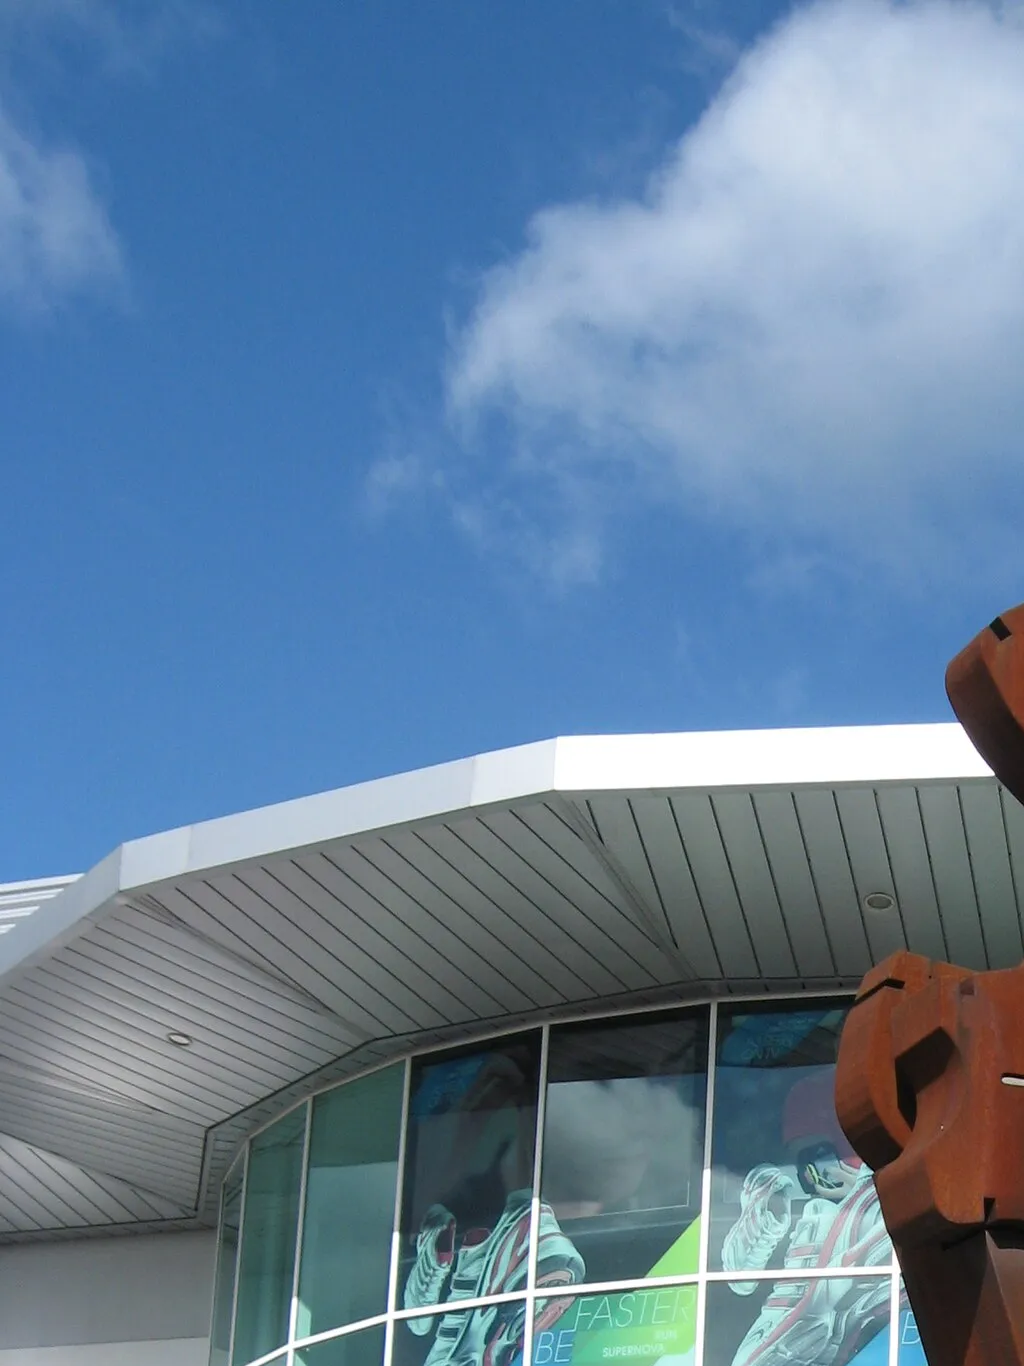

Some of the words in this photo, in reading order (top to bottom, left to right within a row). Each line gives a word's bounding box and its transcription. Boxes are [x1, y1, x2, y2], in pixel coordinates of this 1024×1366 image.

[573, 1288, 695, 1331] FASTER
[534, 1329, 575, 1364] BE
[602, 1343, 666, 1359] SUPERNOVA
